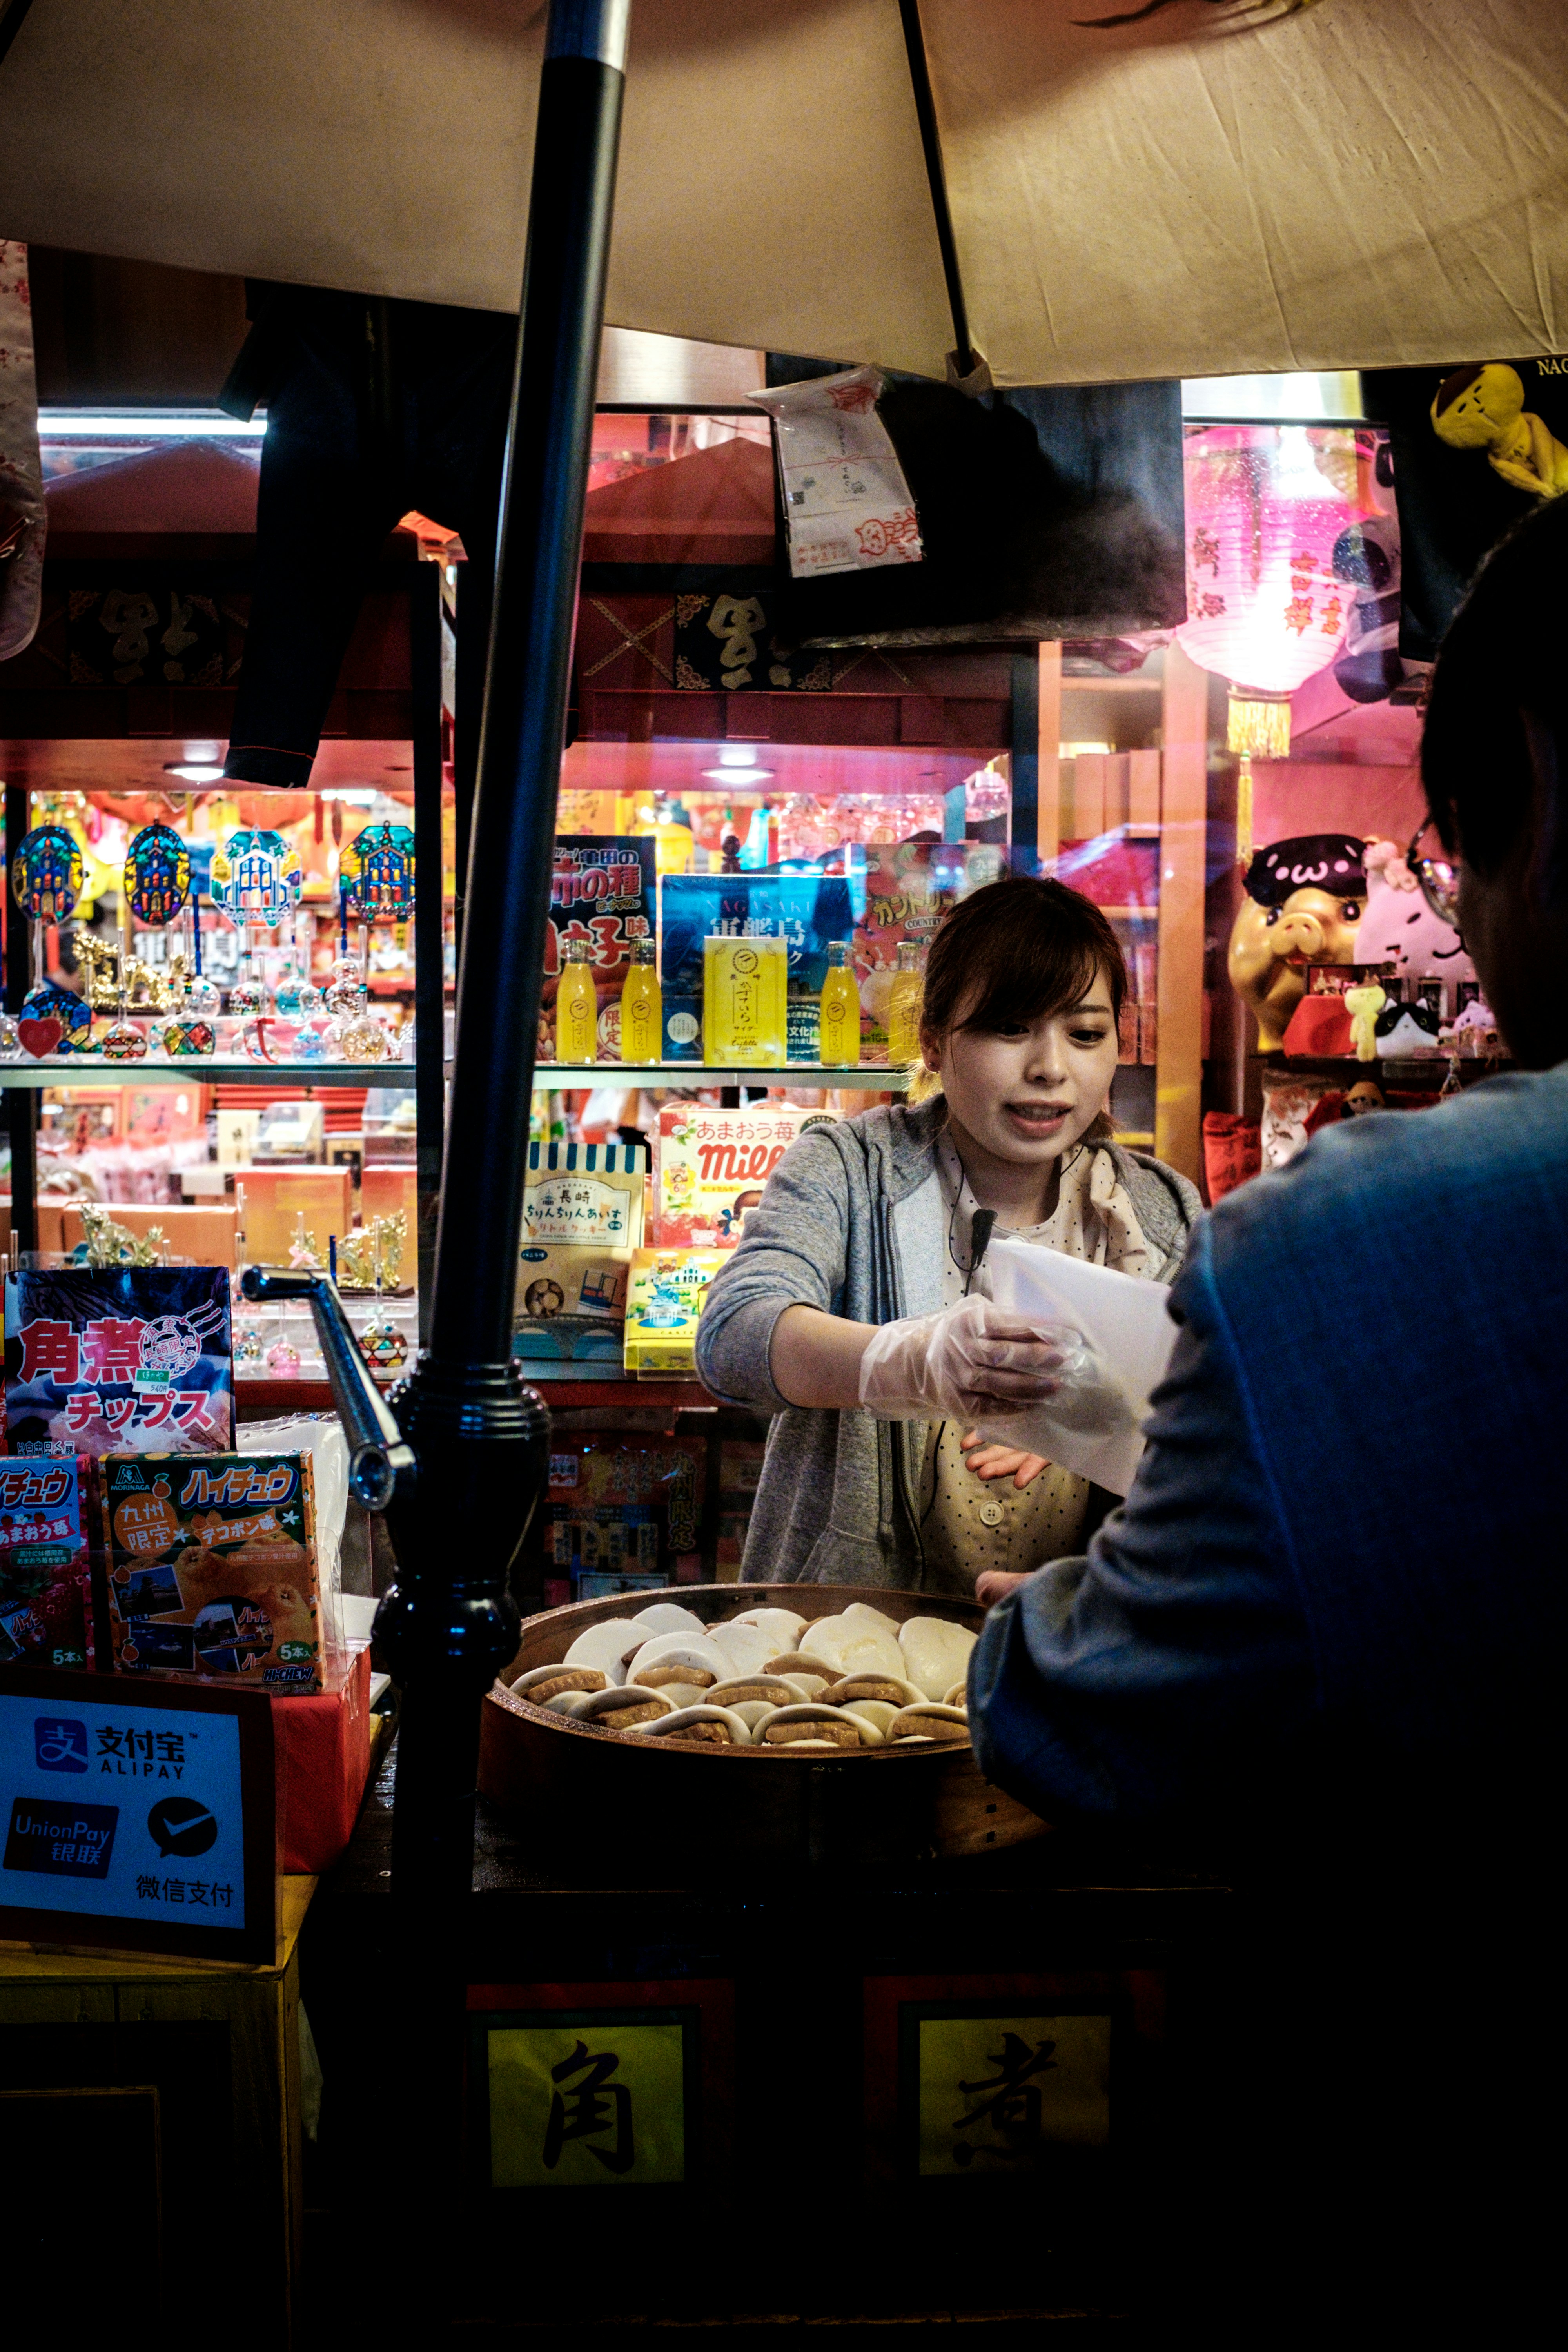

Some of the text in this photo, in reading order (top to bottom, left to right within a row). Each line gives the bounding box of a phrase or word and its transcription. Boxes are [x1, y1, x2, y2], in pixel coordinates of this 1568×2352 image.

[697, 1121, 795, 1140] あまおう苺
[560, 1190, 590, 1205] 長崎
[527, 1204, 621, 1220] ちりんちりんあいす
[18, 1317, 149, 1385] 角煮
[145, 1336, 195, 1360] 長崎限定
[66, 1390, 214, 1432] チップス
[181, 1464, 292, 1504] ハイチュウ
[121, 1502, 165, 1523] 九州
[126, 1525, 171, 1550] 限定
[201, 1514, 276, 1546] デコポン味
[281, 1644, 311, 1660] 5本入
[263, 1667, 313, 1681] HI-CHEW
[96, 1726, 185, 1763] 支付宝
[101, 1759, 183, 1780] ALIPAY
[15, 1815, 110, 1848] UnionPay
[51, 1843, 101, 1865] 银联
[136, 1875, 233, 1907] 微信支付
[542, 2039, 635, 2175] 角
[951, 2032, 1058, 2168] 煮
